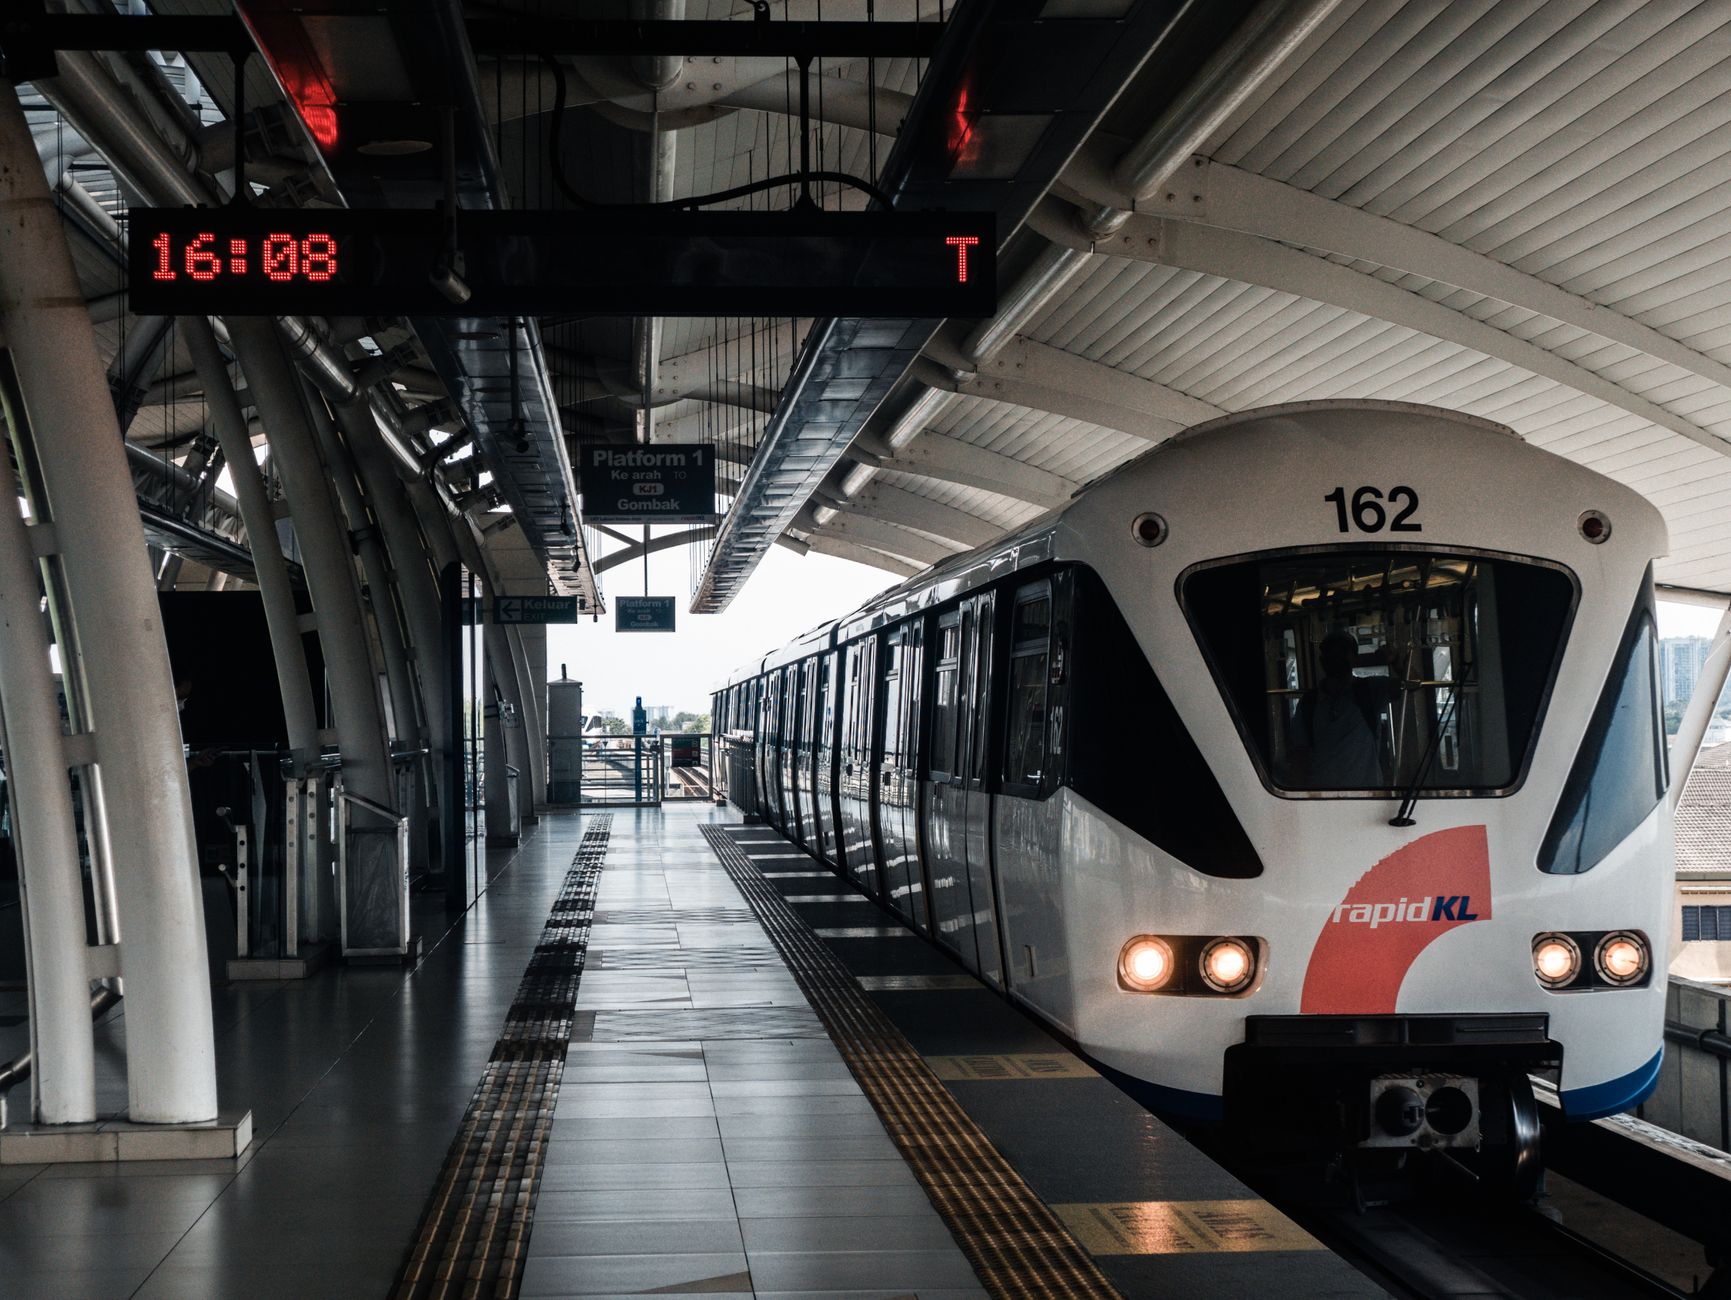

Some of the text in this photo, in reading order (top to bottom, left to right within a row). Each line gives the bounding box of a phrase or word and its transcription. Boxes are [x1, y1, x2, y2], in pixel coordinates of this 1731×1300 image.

[153, 233, 336, 280] 16:08
[945, 236, 979, 282] T
[593, 450, 704, 467] Platform 1
[611, 470, 629, 481] Ke
[631, 470, 661, 481] arah
[617, 498, 680, 511] Gombak
[1324, 486, 1422, 533] 162
[524, 599, 571, 610] Keluar
[619, 599, 662, 608] Platform
[1329, 895, 1479, 929] rapidKL
